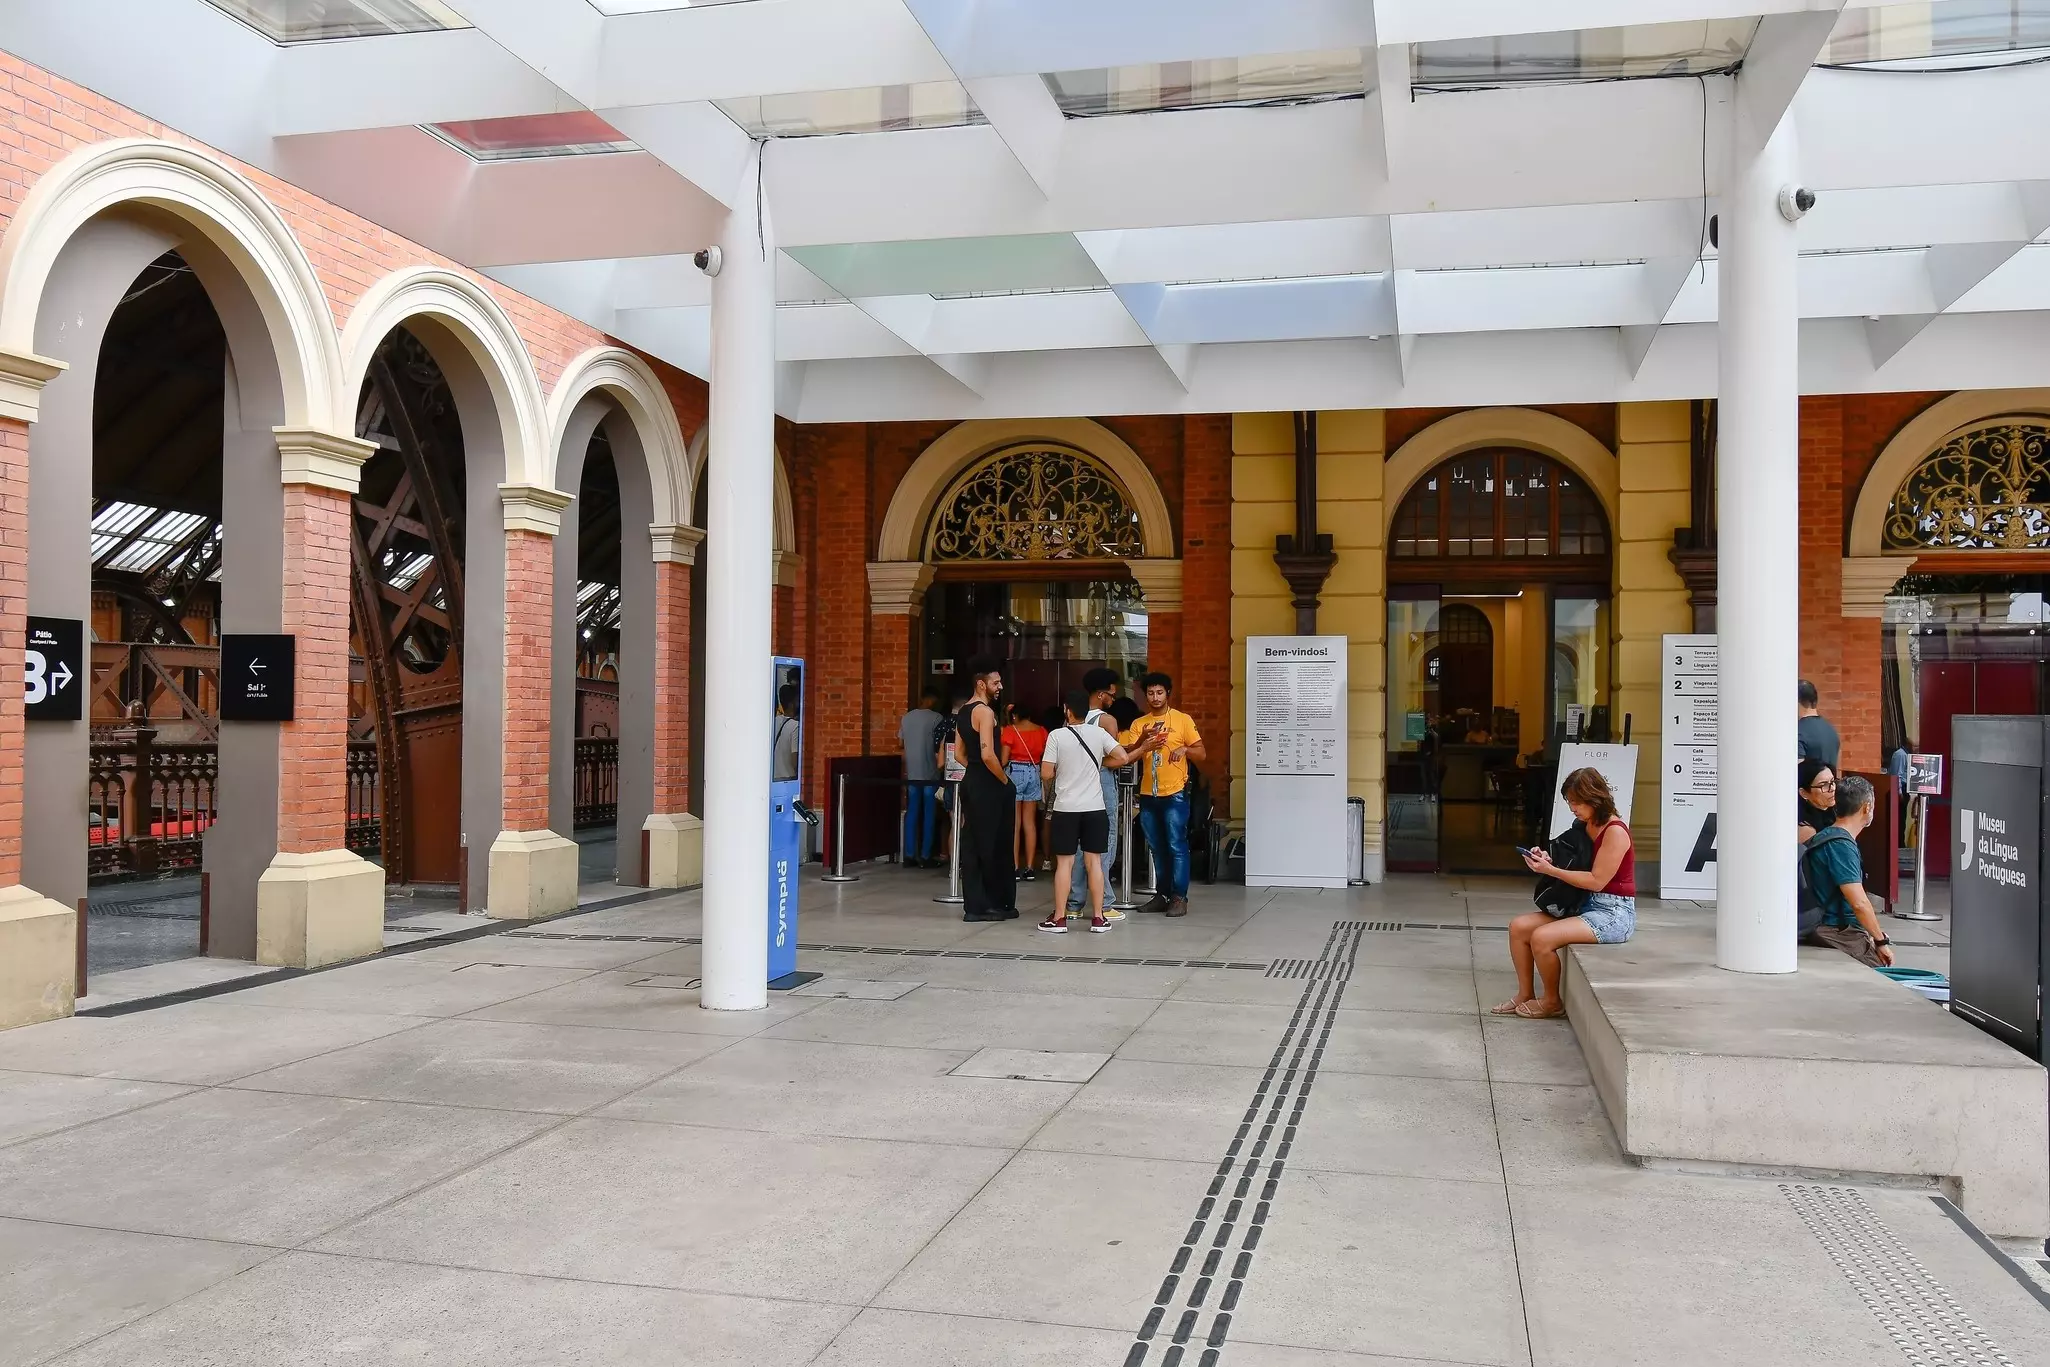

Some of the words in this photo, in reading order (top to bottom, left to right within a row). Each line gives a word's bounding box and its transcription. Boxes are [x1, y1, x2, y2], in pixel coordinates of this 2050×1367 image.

[1265, 647, 1328, 656] Bem-vindos!
[1675, 656, 1682, 665] 3
[1674, 680, 1682, 690] 2
[1674, 715, 1680, 724] 1
[1674, 764, 1682, 773] 0
[1978, 811, 2006, 834] Museu
[1978, 835, 1989, 855] da
[1989, 837, 2018, 863] Língua
[1978, 858, 2027, 888] Portuguesa
